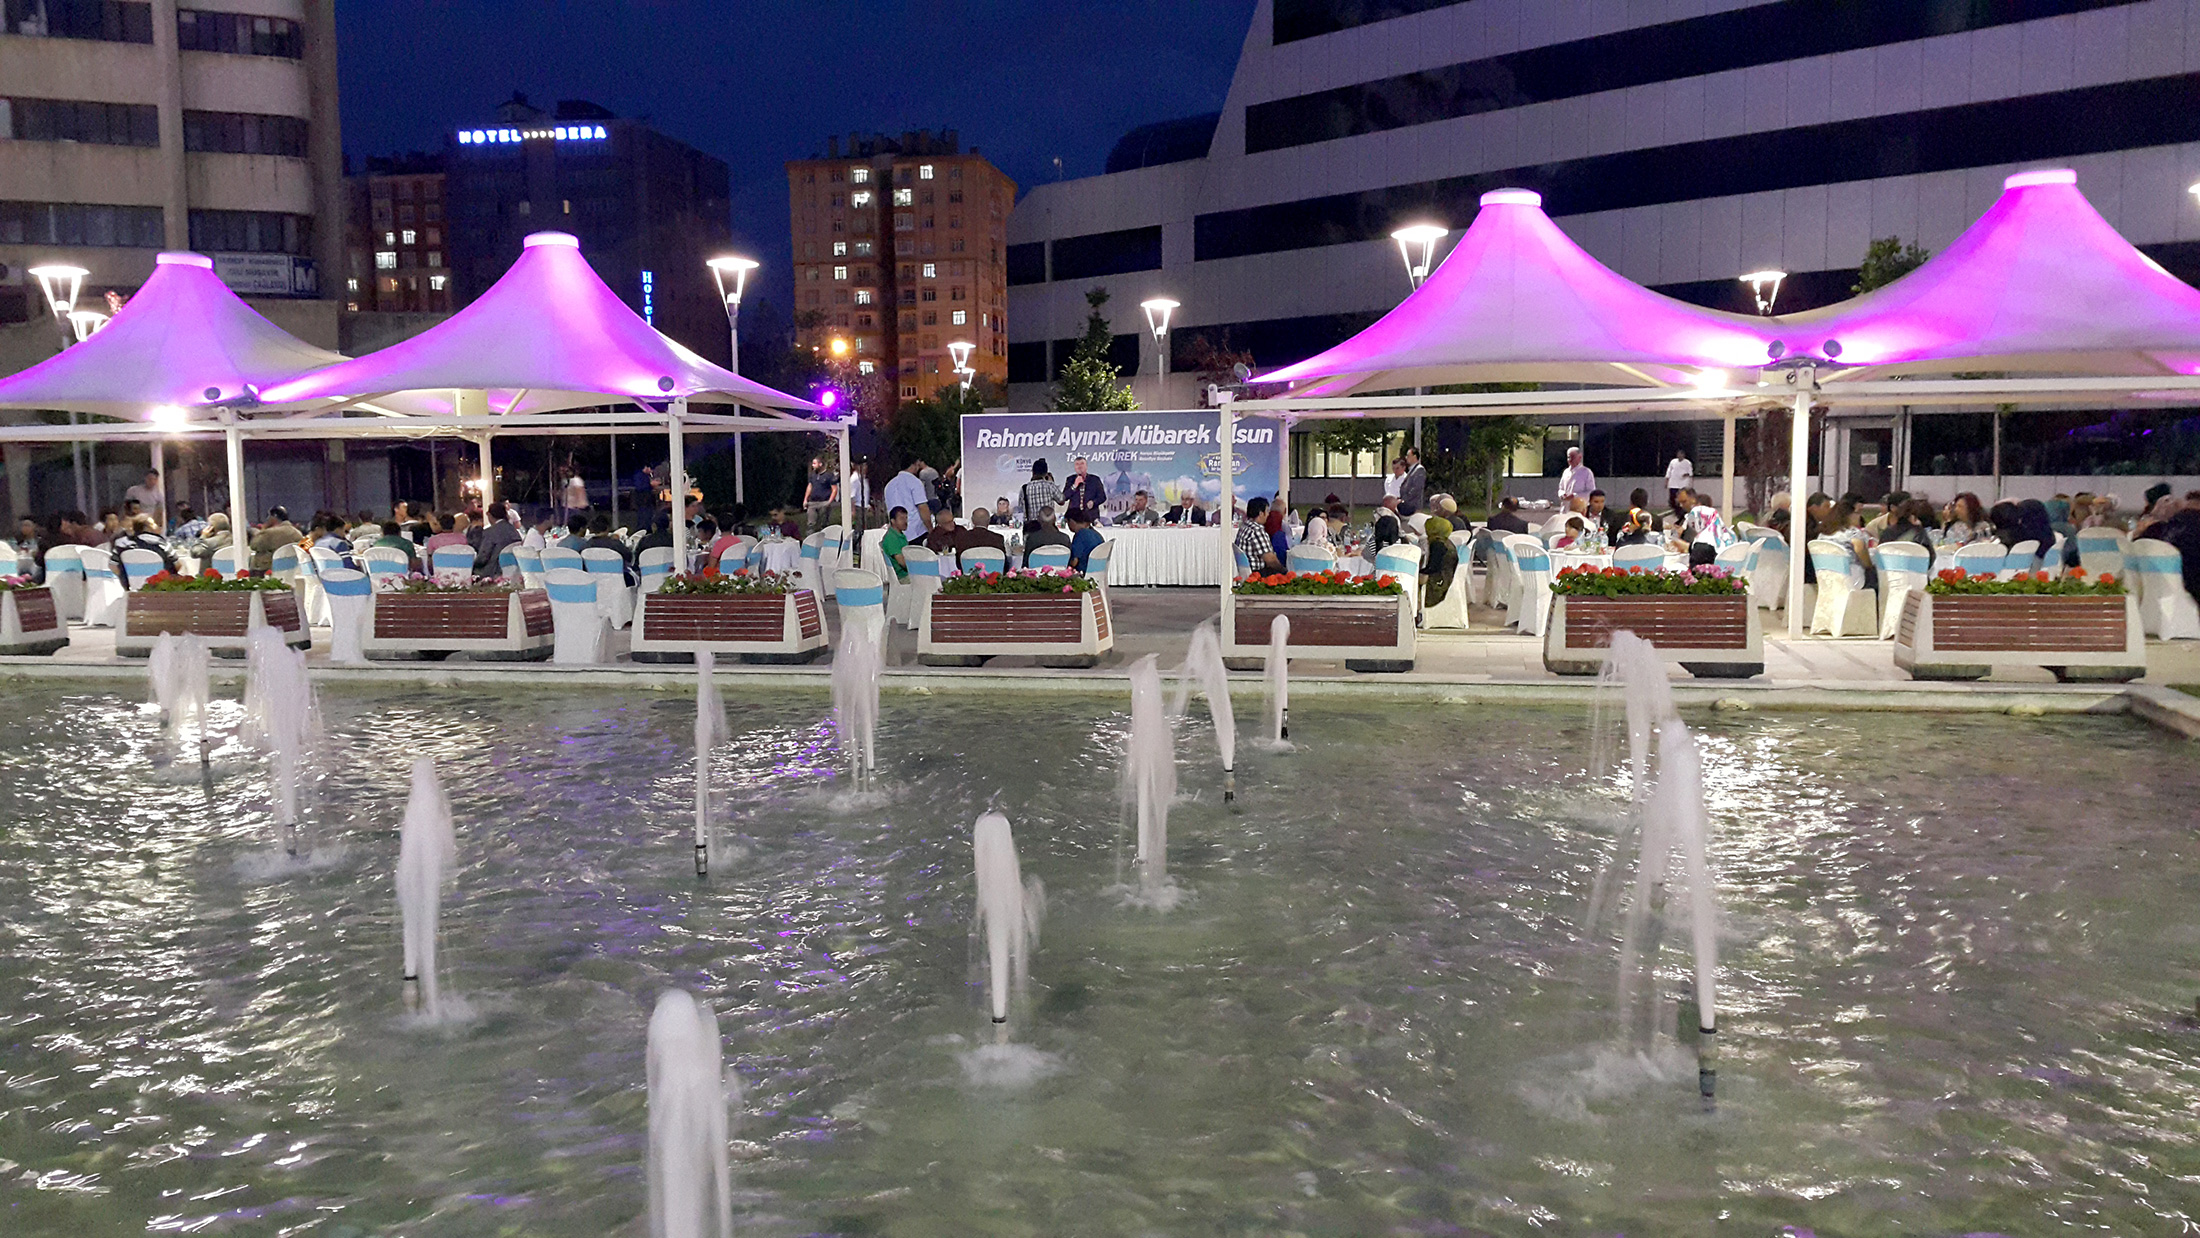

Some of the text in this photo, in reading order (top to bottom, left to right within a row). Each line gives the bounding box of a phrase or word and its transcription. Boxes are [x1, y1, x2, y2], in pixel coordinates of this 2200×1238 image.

[458, 126, 607, 144] HOTEL BERA
[977, 428, 1054, 448] Rahmet
[1056, 427, 1117, 450] Ayınız
[1121, 424, 1211, 445] Mübarek
[1091, 449, 1138, 462] AKYÜREK
